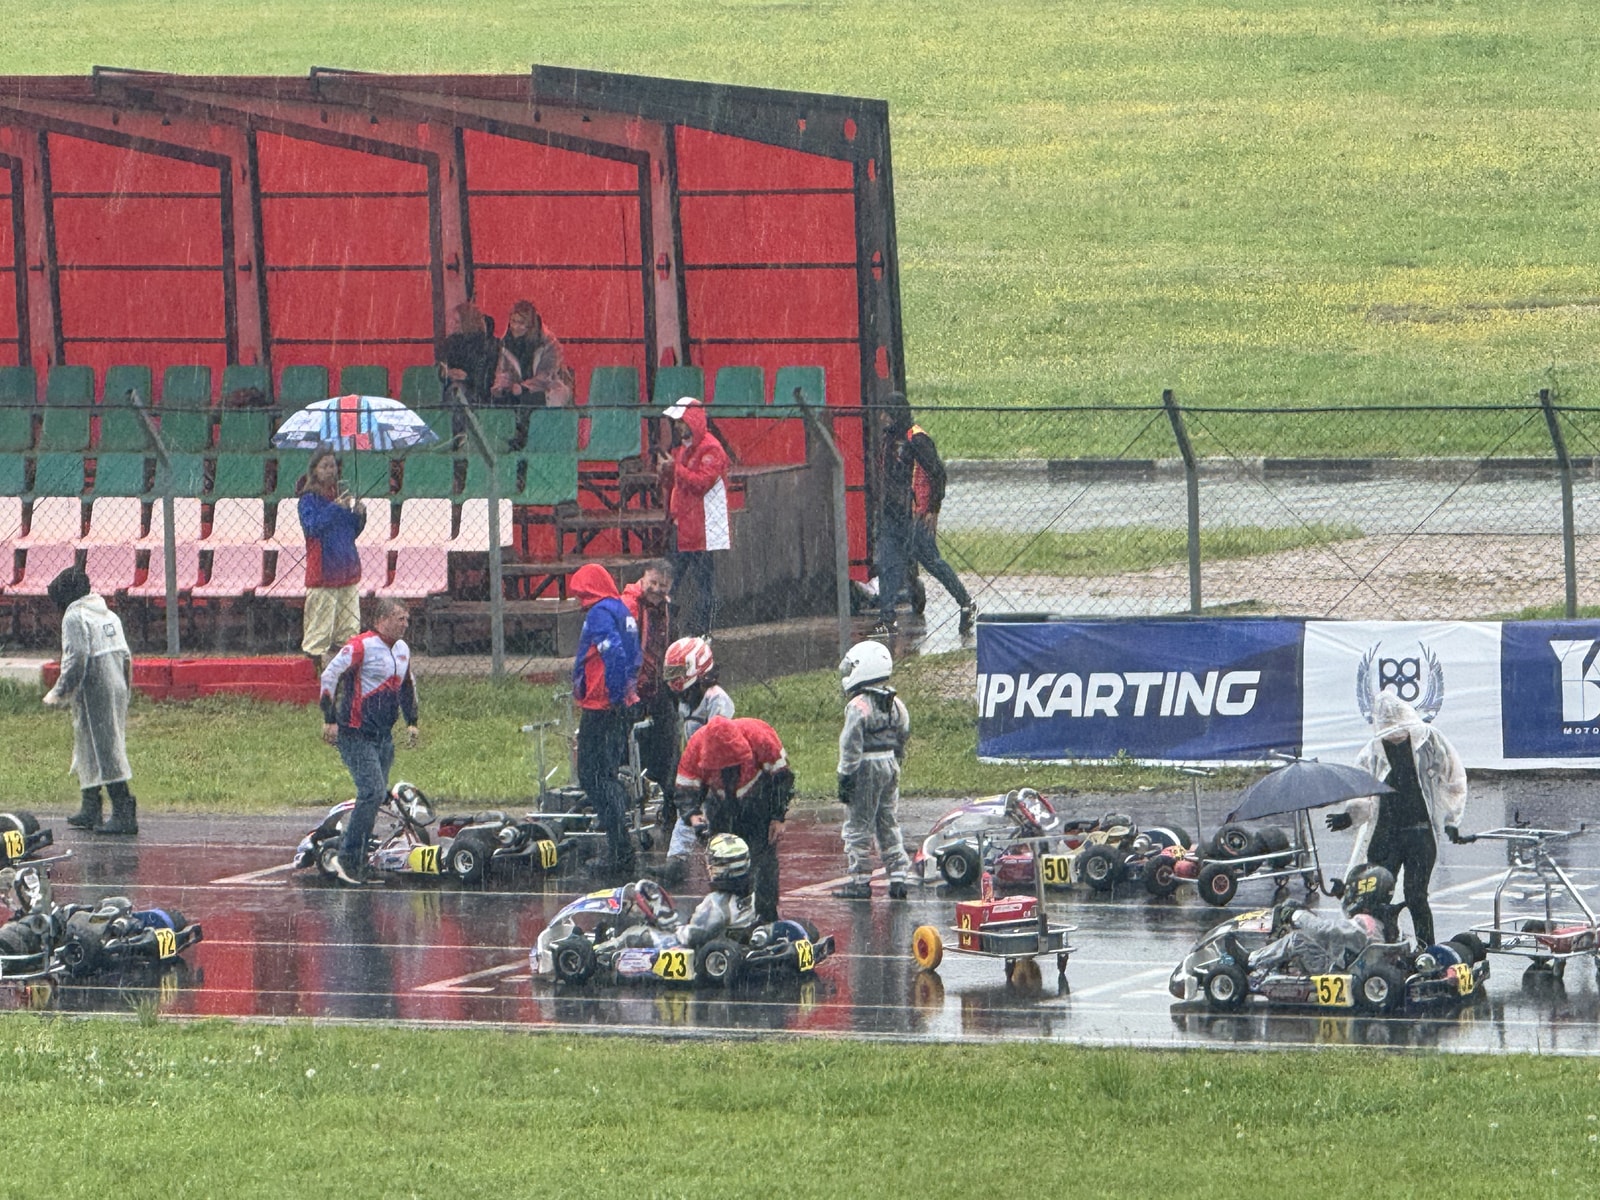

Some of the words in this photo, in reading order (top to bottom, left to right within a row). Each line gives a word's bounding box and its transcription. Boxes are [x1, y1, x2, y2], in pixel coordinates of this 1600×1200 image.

[8, 832, 23, 857] 13
[421, 848, 434, 872] 12
[1044, 857, 1069, 881] 50
[1357, 876, 1377, 895] 52
[661, 951, 687, 977] 23
[797, 941, 813, 968] 23
[1320, 976, 1346, 1003] 52
